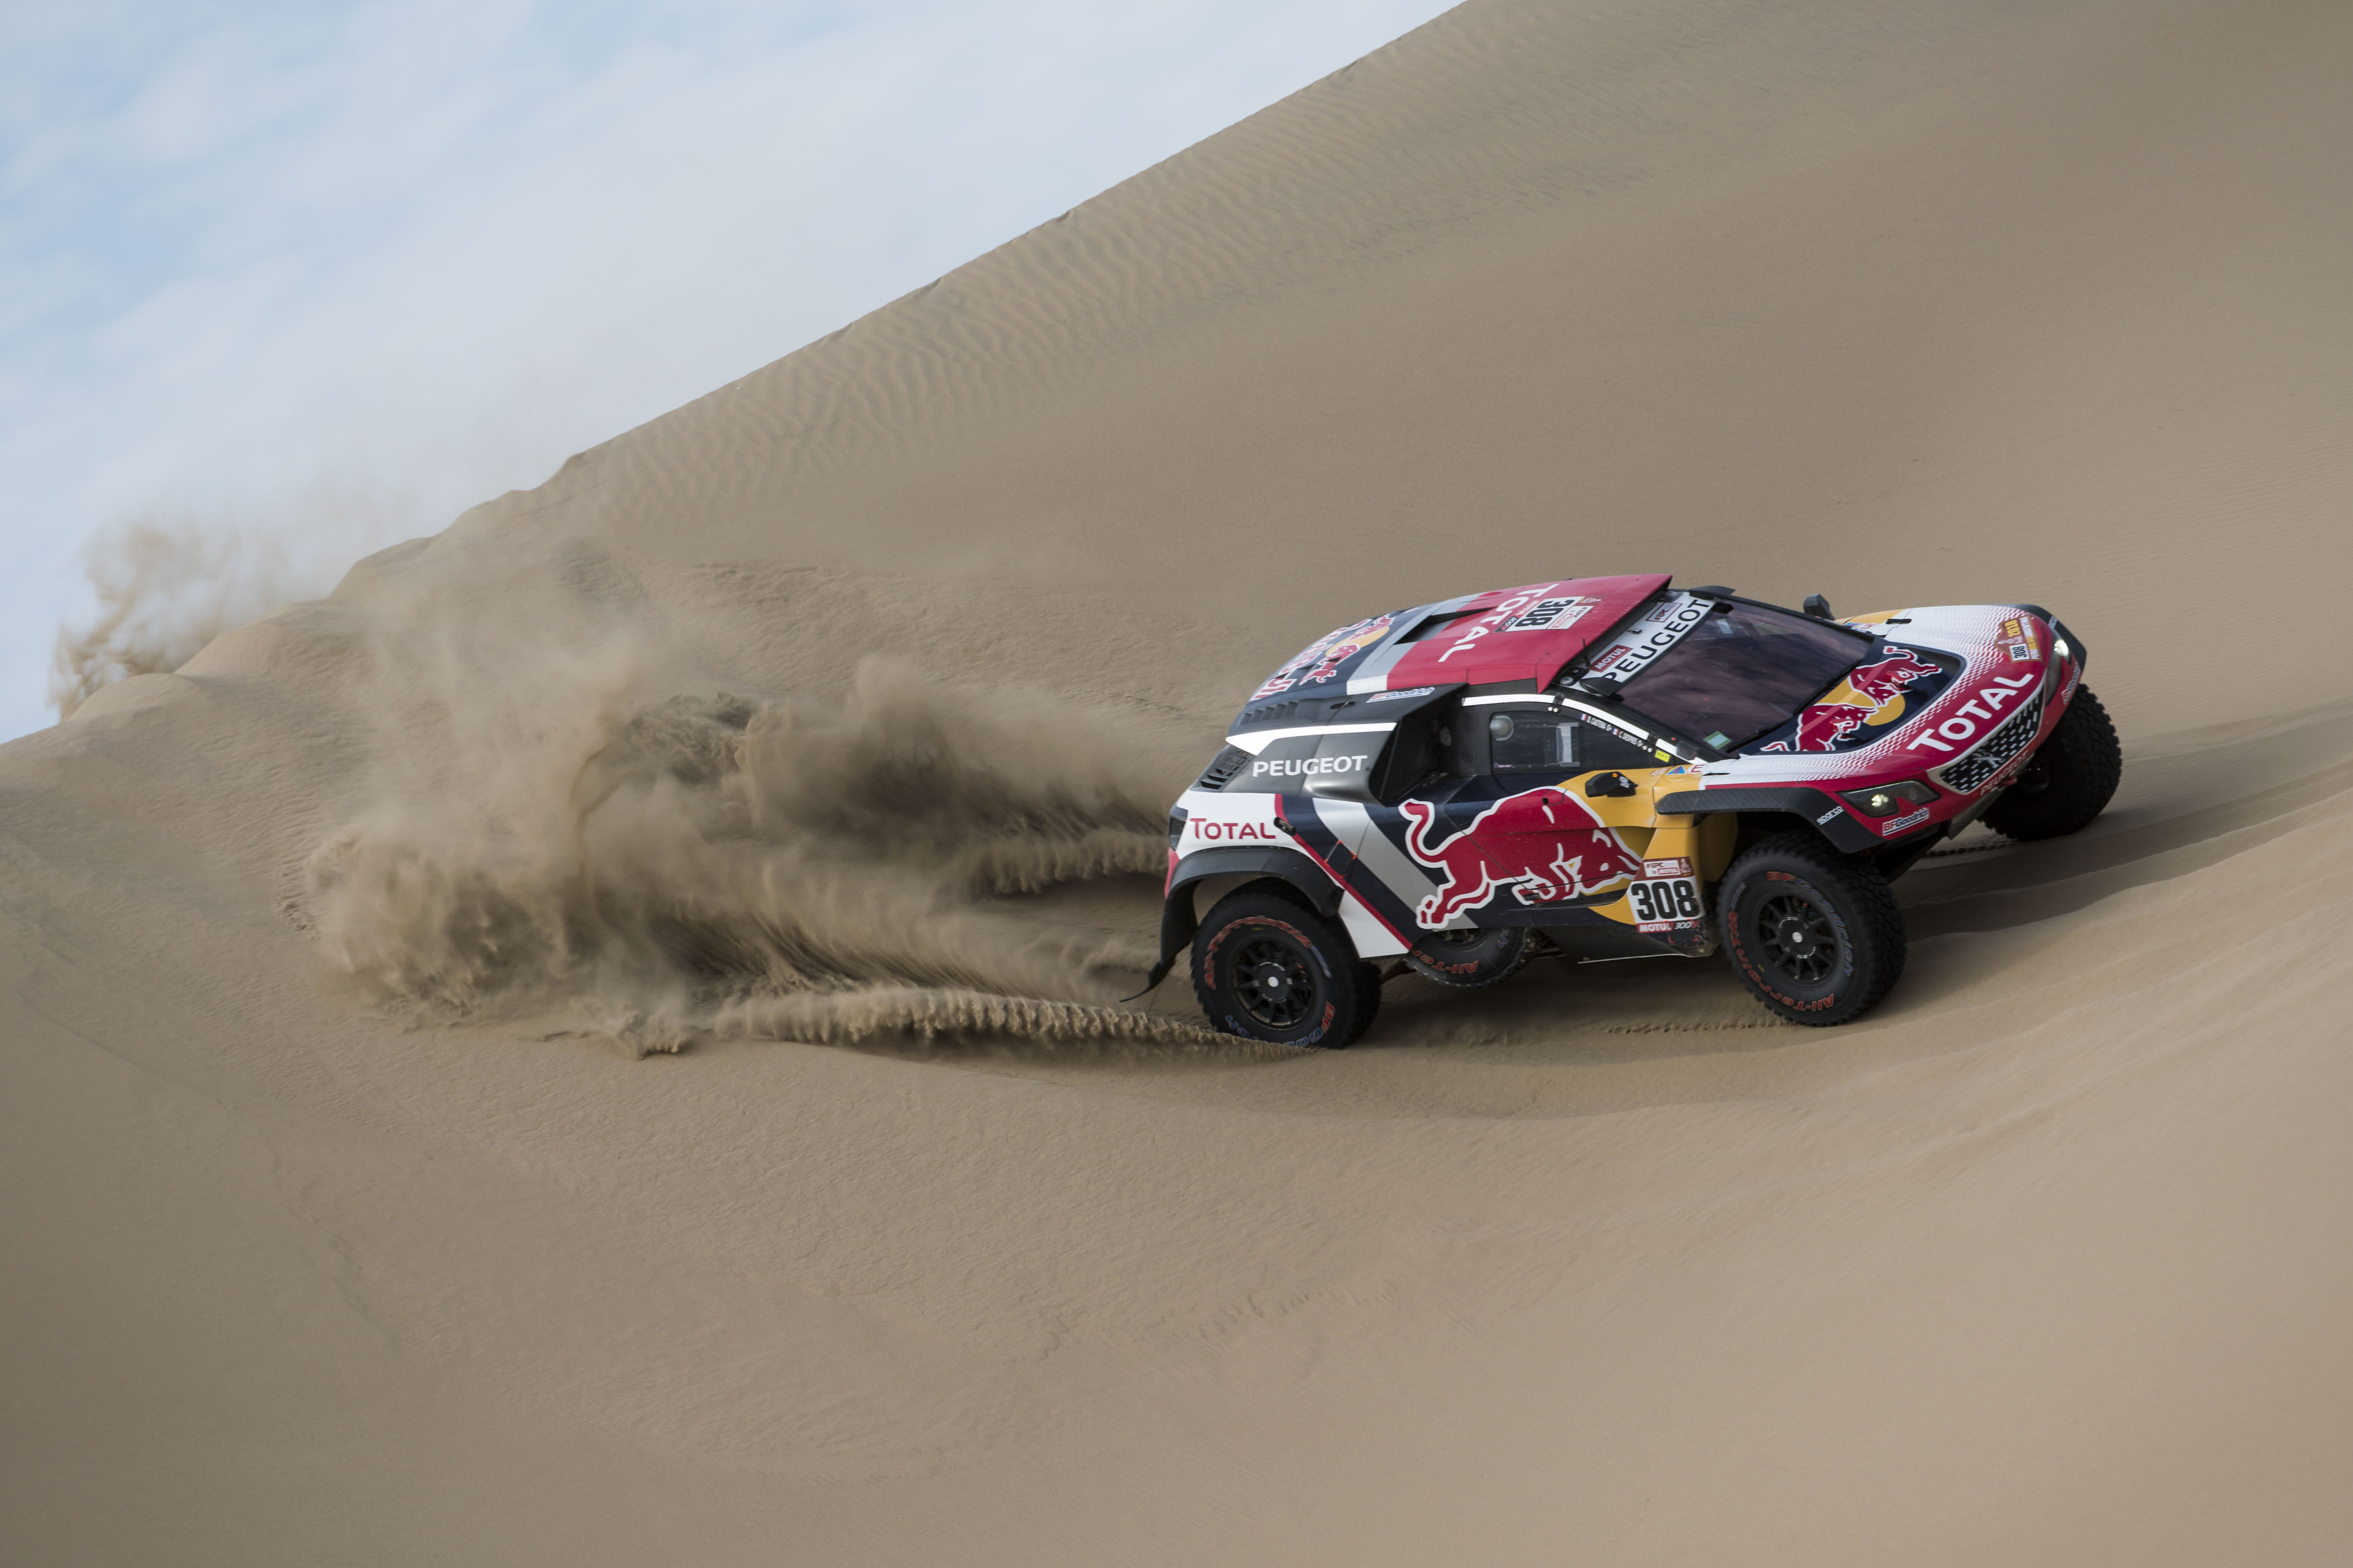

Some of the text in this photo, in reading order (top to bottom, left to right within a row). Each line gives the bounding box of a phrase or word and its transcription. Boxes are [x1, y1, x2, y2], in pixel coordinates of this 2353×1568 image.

[1437, 583, 1559, 662] TOTAL
[1514, 599, 1575, 627] 308
[1603, 600, 1709, 680] PEUGEOT
[2005, 620, 2021, 637] 2018
[1595, 647, 1626, 669] MOTUL
[2012, 646, 2027, 659] 308
[1906, 673, 2034, 751] TOTAL
[1252, 755, 1367, 777] PEUGEOT
[1817, 807, 1842, 824] sparco
[1884, 808, 1929, 832] BFGoodrich
[1190, 818, 1276, 839] TOTAL
[1631, 880, 1700, 921] 308
[1639, 923, 1672, 932] MOTUL
[1412, 949, 1478, 974] All-Ter
[1737, 948, 1835, 1012] All-Terrain
